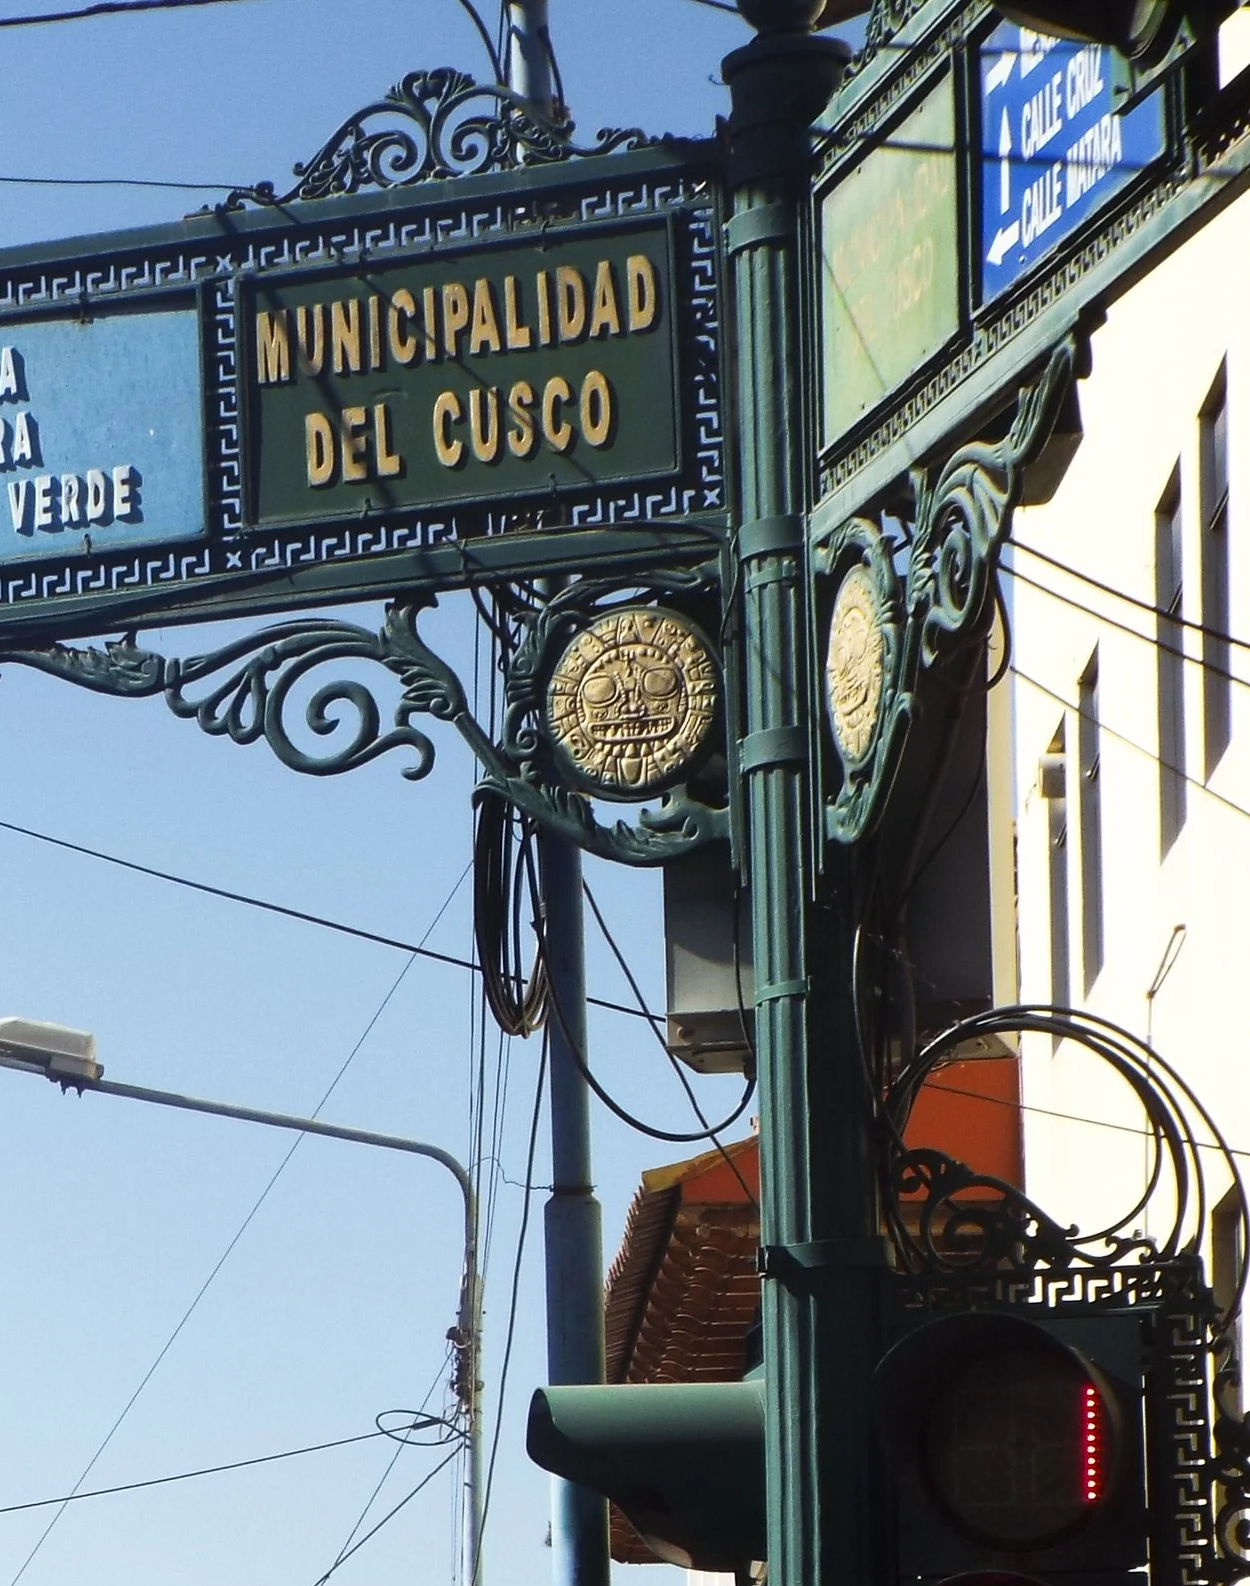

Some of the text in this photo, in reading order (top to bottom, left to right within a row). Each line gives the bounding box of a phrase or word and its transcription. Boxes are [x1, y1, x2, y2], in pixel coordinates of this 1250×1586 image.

[1022, 71, 1062, 161] CALLE
[1067, 42, 1103, 120] CRUZ
[1022, 160, 1062, 247] CALLE
[1067, 113, 1122, 208] MATARA
[257, 254, 656, 384] MUNICIPALIDAD
[306, 370, 611, 487] DEL CUSCO
[8, 465, 133, 531] VERDE
